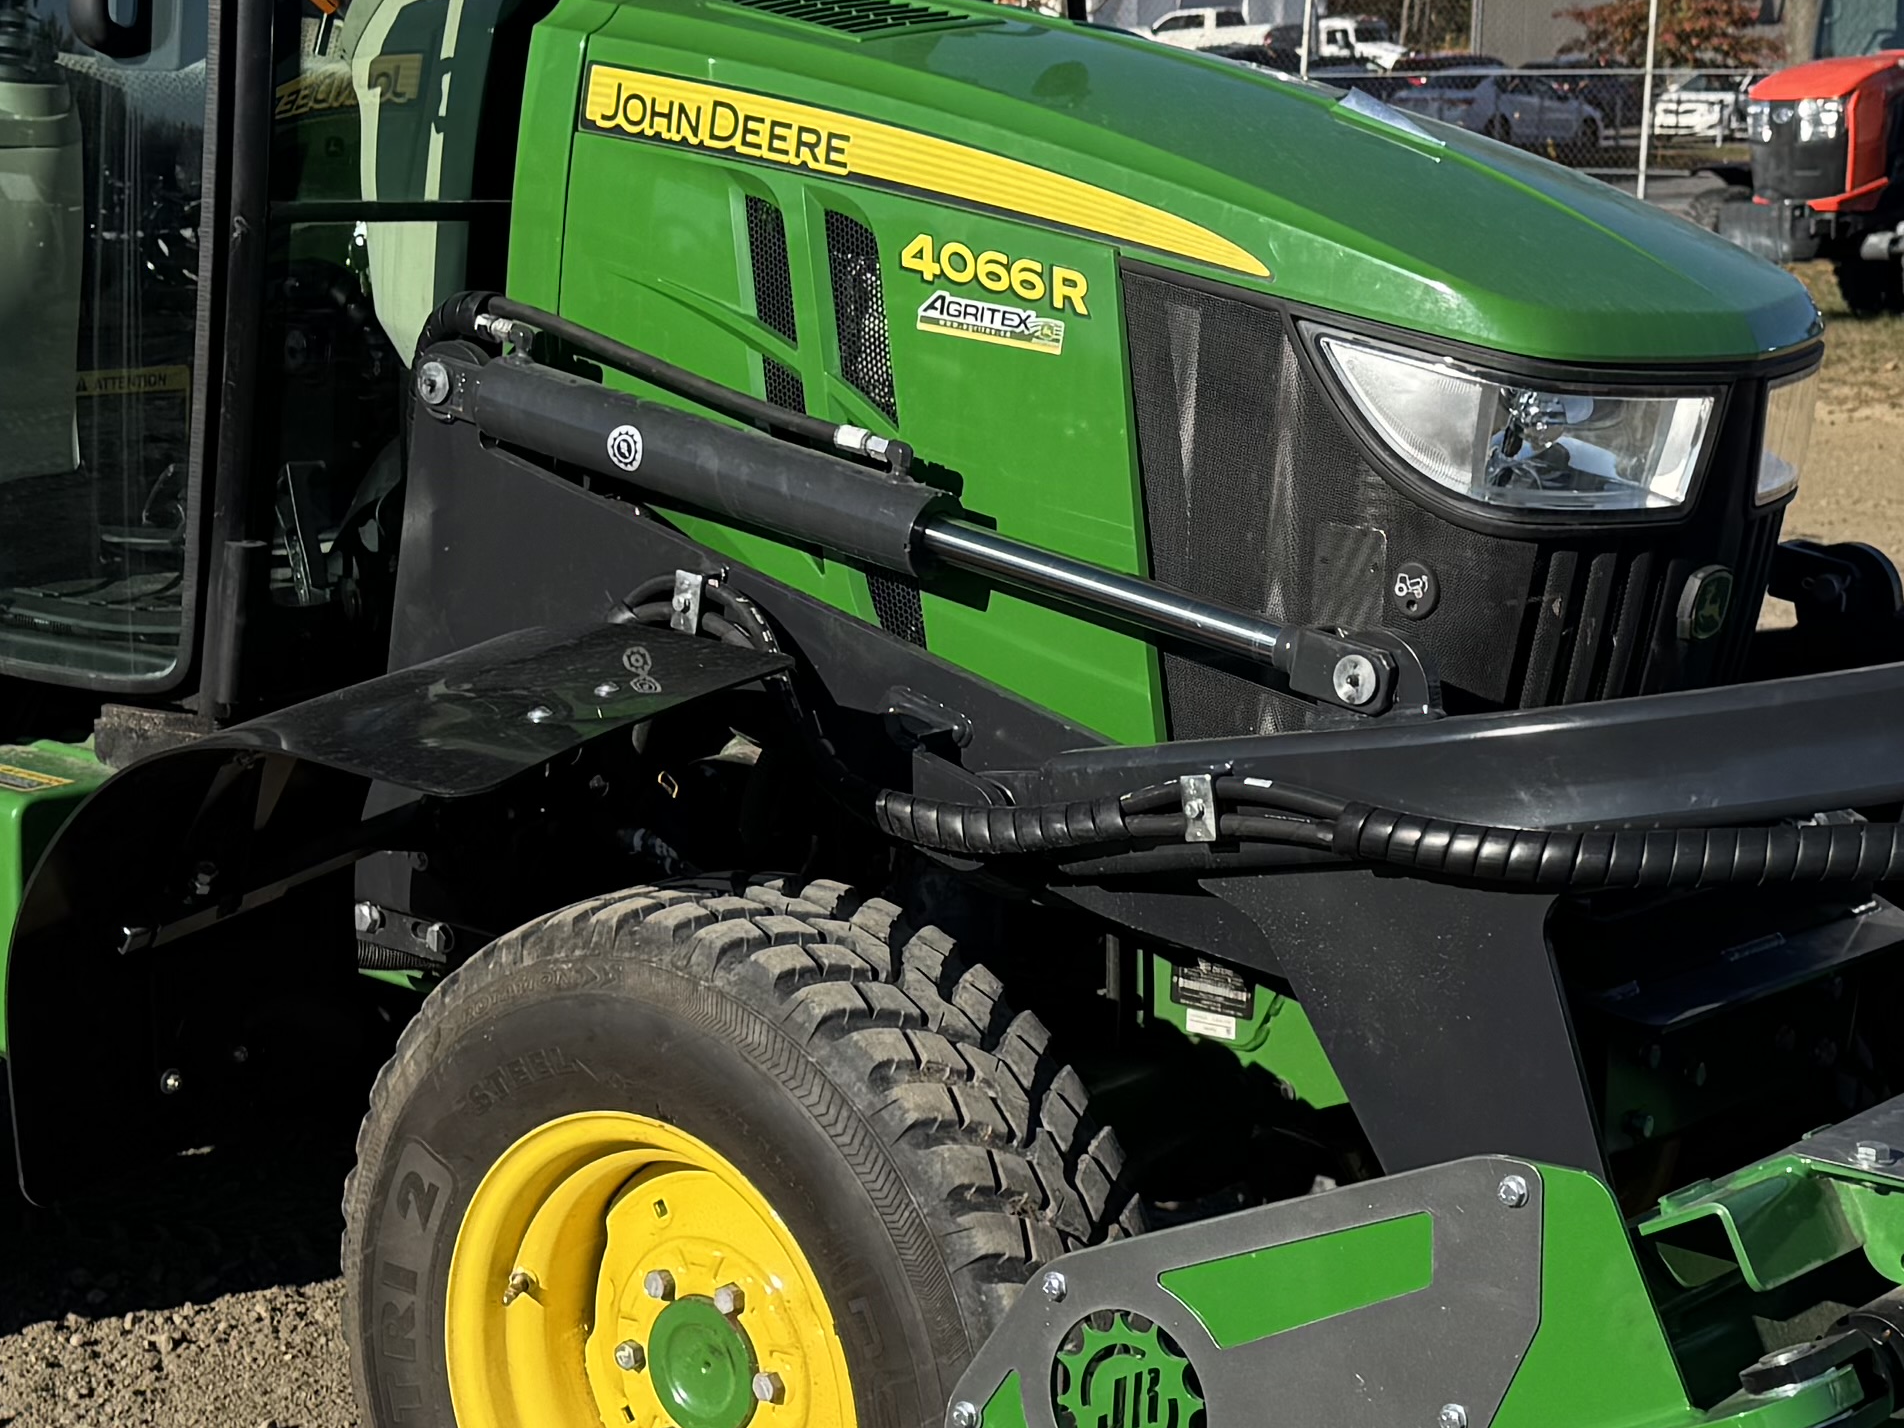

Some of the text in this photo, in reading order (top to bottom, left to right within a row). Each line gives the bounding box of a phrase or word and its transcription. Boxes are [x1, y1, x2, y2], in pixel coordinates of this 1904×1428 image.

[600, 82, 851, 169] JOHN DEERE
[922, 294, 1032, 333] AGRITEX
[379, 1169, 441, 1423] TRI 2
